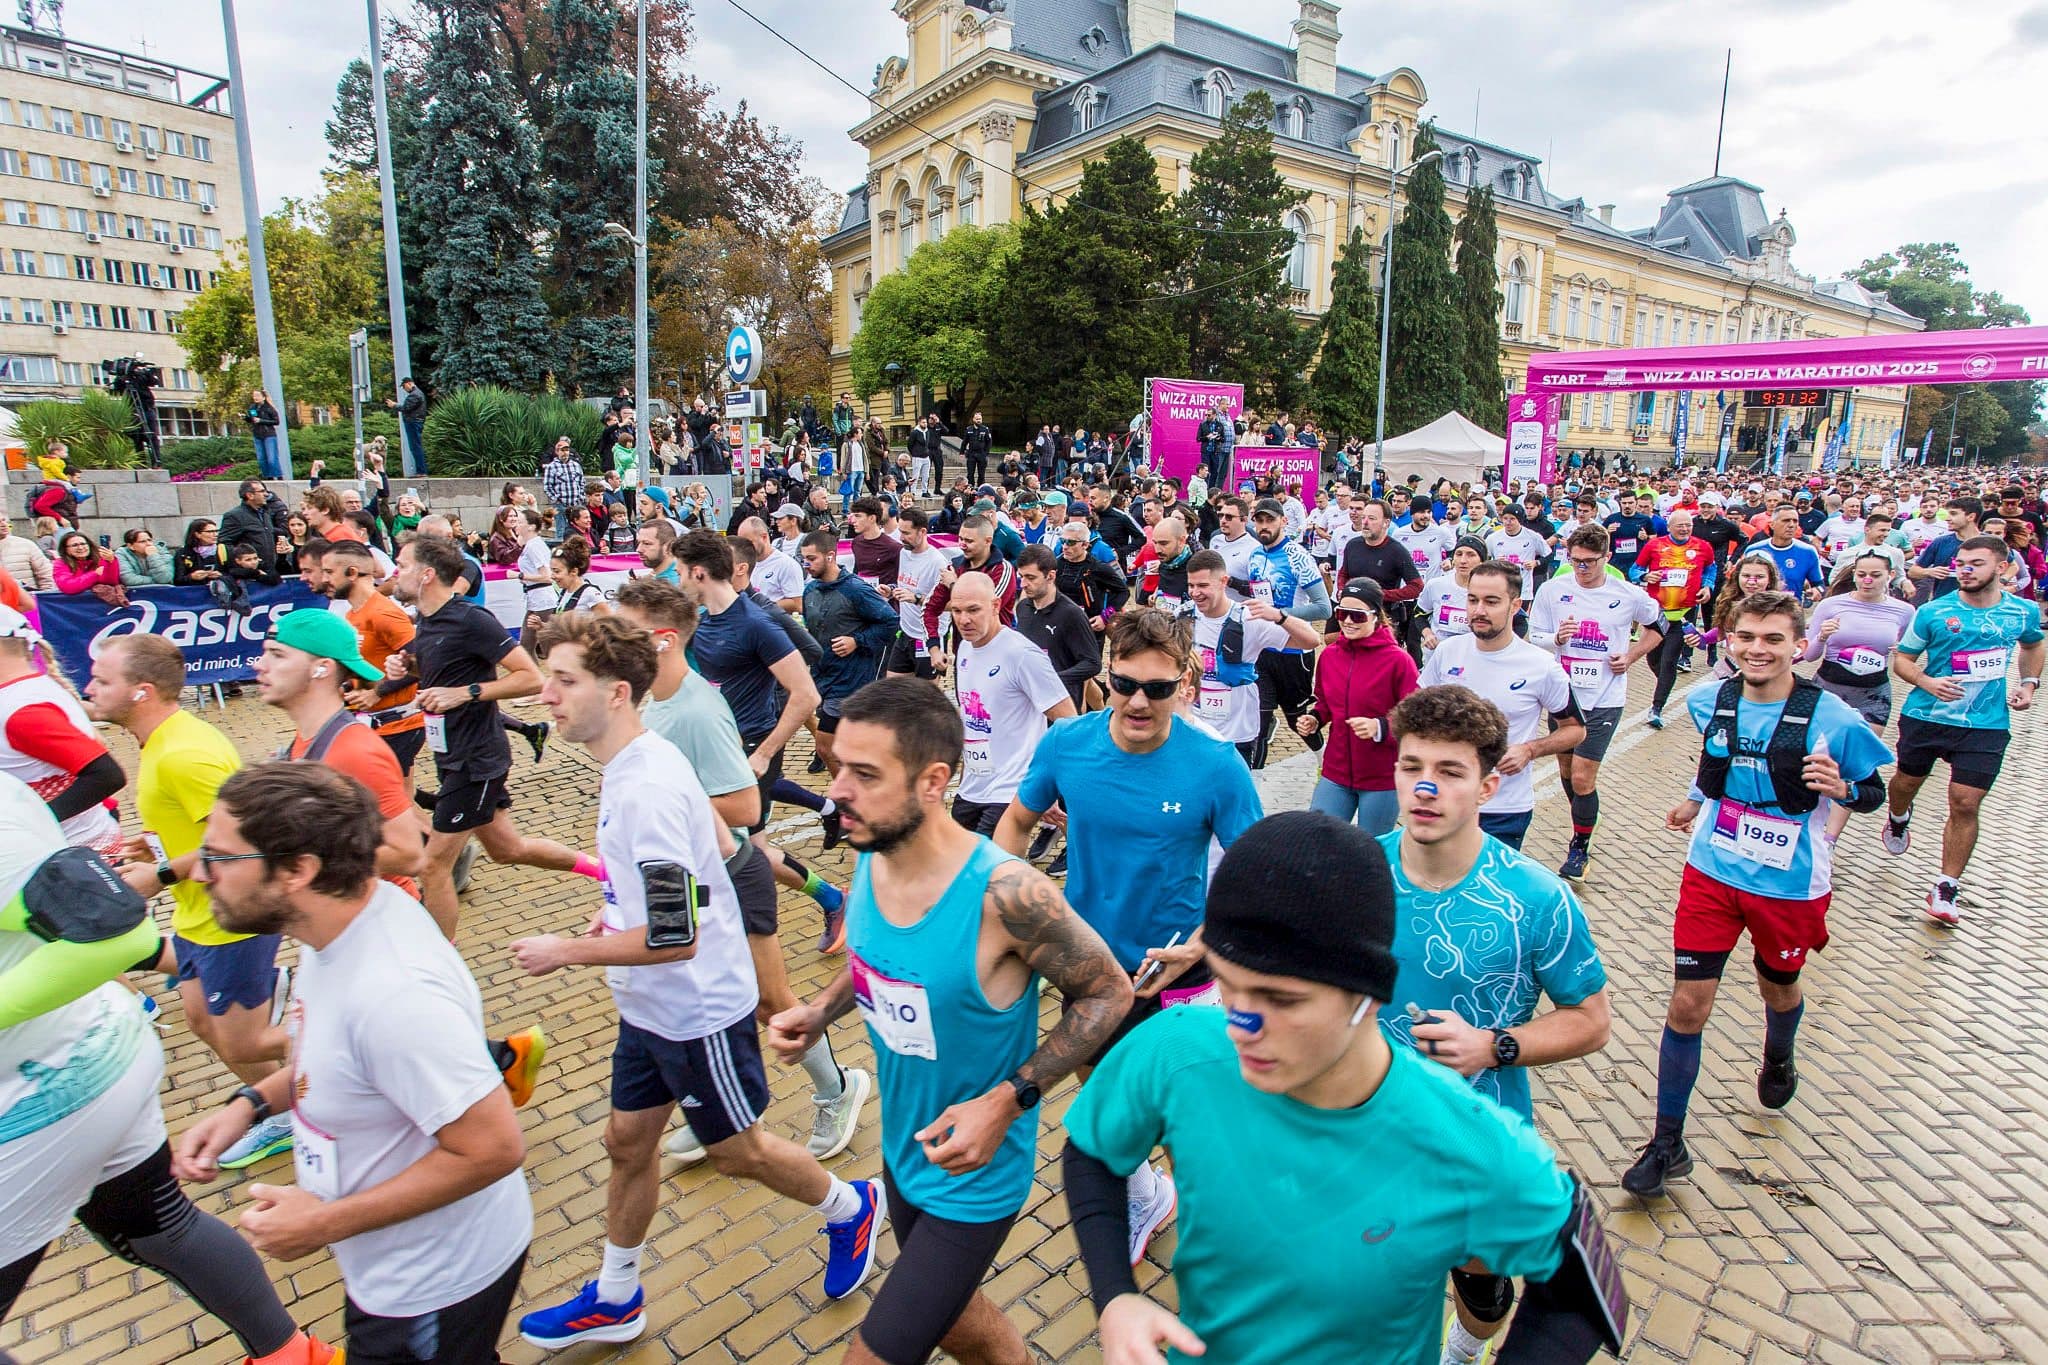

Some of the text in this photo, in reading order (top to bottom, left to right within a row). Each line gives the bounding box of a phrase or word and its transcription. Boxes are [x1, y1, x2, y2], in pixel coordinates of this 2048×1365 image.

[1643, 361, 1940, 383] WIZZ AIR SOFIA MARATHON 2025
[1542, 373, 1587, 386] START
[1159, 391, 1187, 405] WIZZ
[1189, 393, 1206, 406] AIR
[1170, 407, 1208, 420] MARAT
[1240, 458, 1267, 472] WIZZ
[1286, 459, 1314, 472] SOFIA
[1277, 474, 1304, 486] THON
[184, 657, 202, 672] nd
[205, 654, 243, 671] mind,
[1856, 653, 1882, 669] 1954
[1974, 657, 2002, 669] 1955
[1573, 666, 1598, 676] 3178
[1206, 697, 1223, 708] 731
[1743, 823, 1789, 847] 1989
